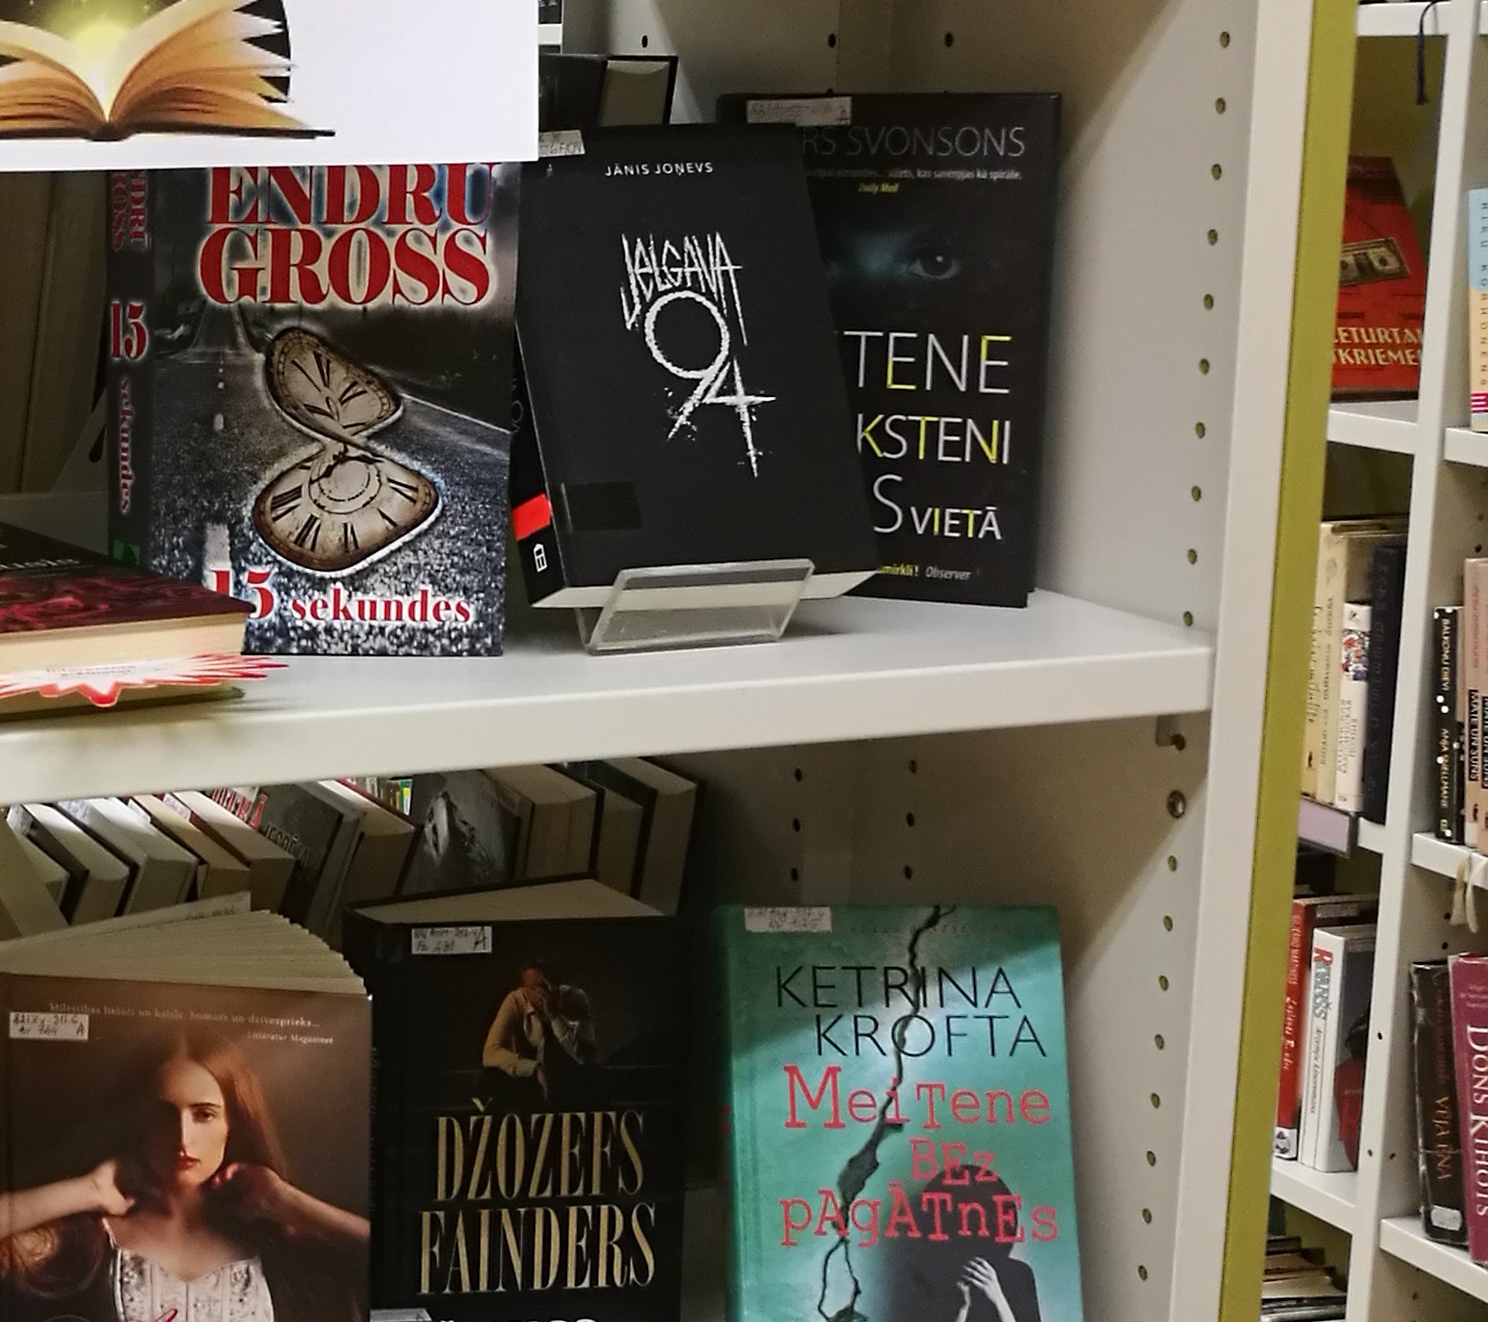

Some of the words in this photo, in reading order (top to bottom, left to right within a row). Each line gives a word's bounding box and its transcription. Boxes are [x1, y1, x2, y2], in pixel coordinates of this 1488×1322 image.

[605, 162, 651, 178] JĀNIS
[654, 160, 715, 179] JOŅEVS
[846, 126, 1027, 158] SVONSONS
[209, 162, 499, 226] ENDRU
[198, 228, 494, 307] GROSS
[110, 301, 148, 363] 15
[118, 376, 137, 515] sekundes
[290, 587, 472, 624] sekundes
[775, 965, 1024, 1010] KETRINA
[815, 1014, 1047, 1058] KROFTA
[433, 1096, 646, 1203] DŽOZEFS
[416, 1202, 657, 1295] FAINDERS
